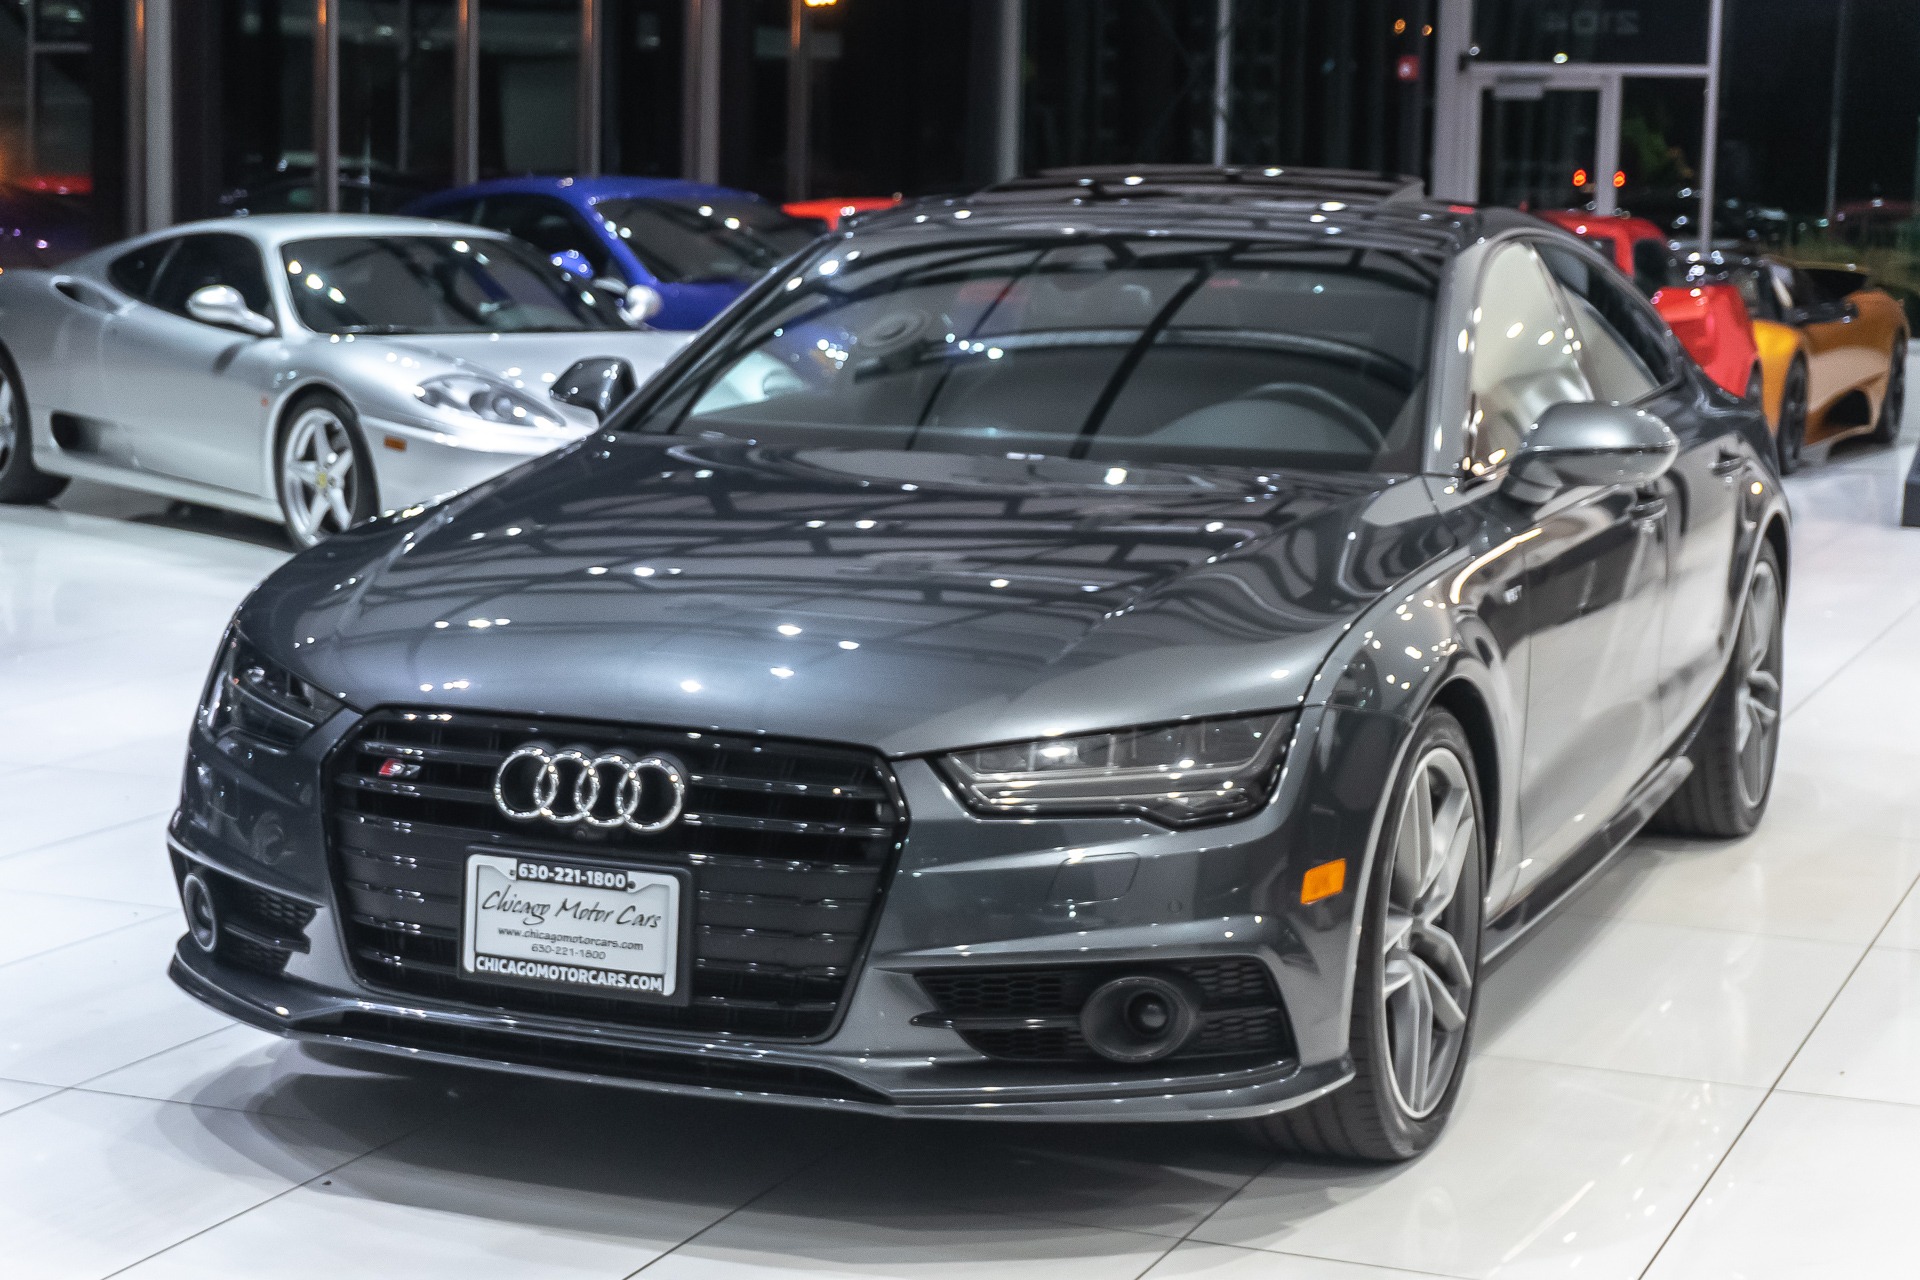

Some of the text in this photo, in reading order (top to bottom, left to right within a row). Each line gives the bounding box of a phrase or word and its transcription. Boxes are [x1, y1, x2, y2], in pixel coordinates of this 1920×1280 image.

[518, 863, 627, 888] 630-221-1800
[481, 884, 661, 928] Chicago Motor Cars
[498, 927, 643, 950] www.chicagomotorcars.com
[531, 943, 606, 960] 630-221-1800
[475, 956, 663, 992] CHICAGOMOTORCARS.COM
